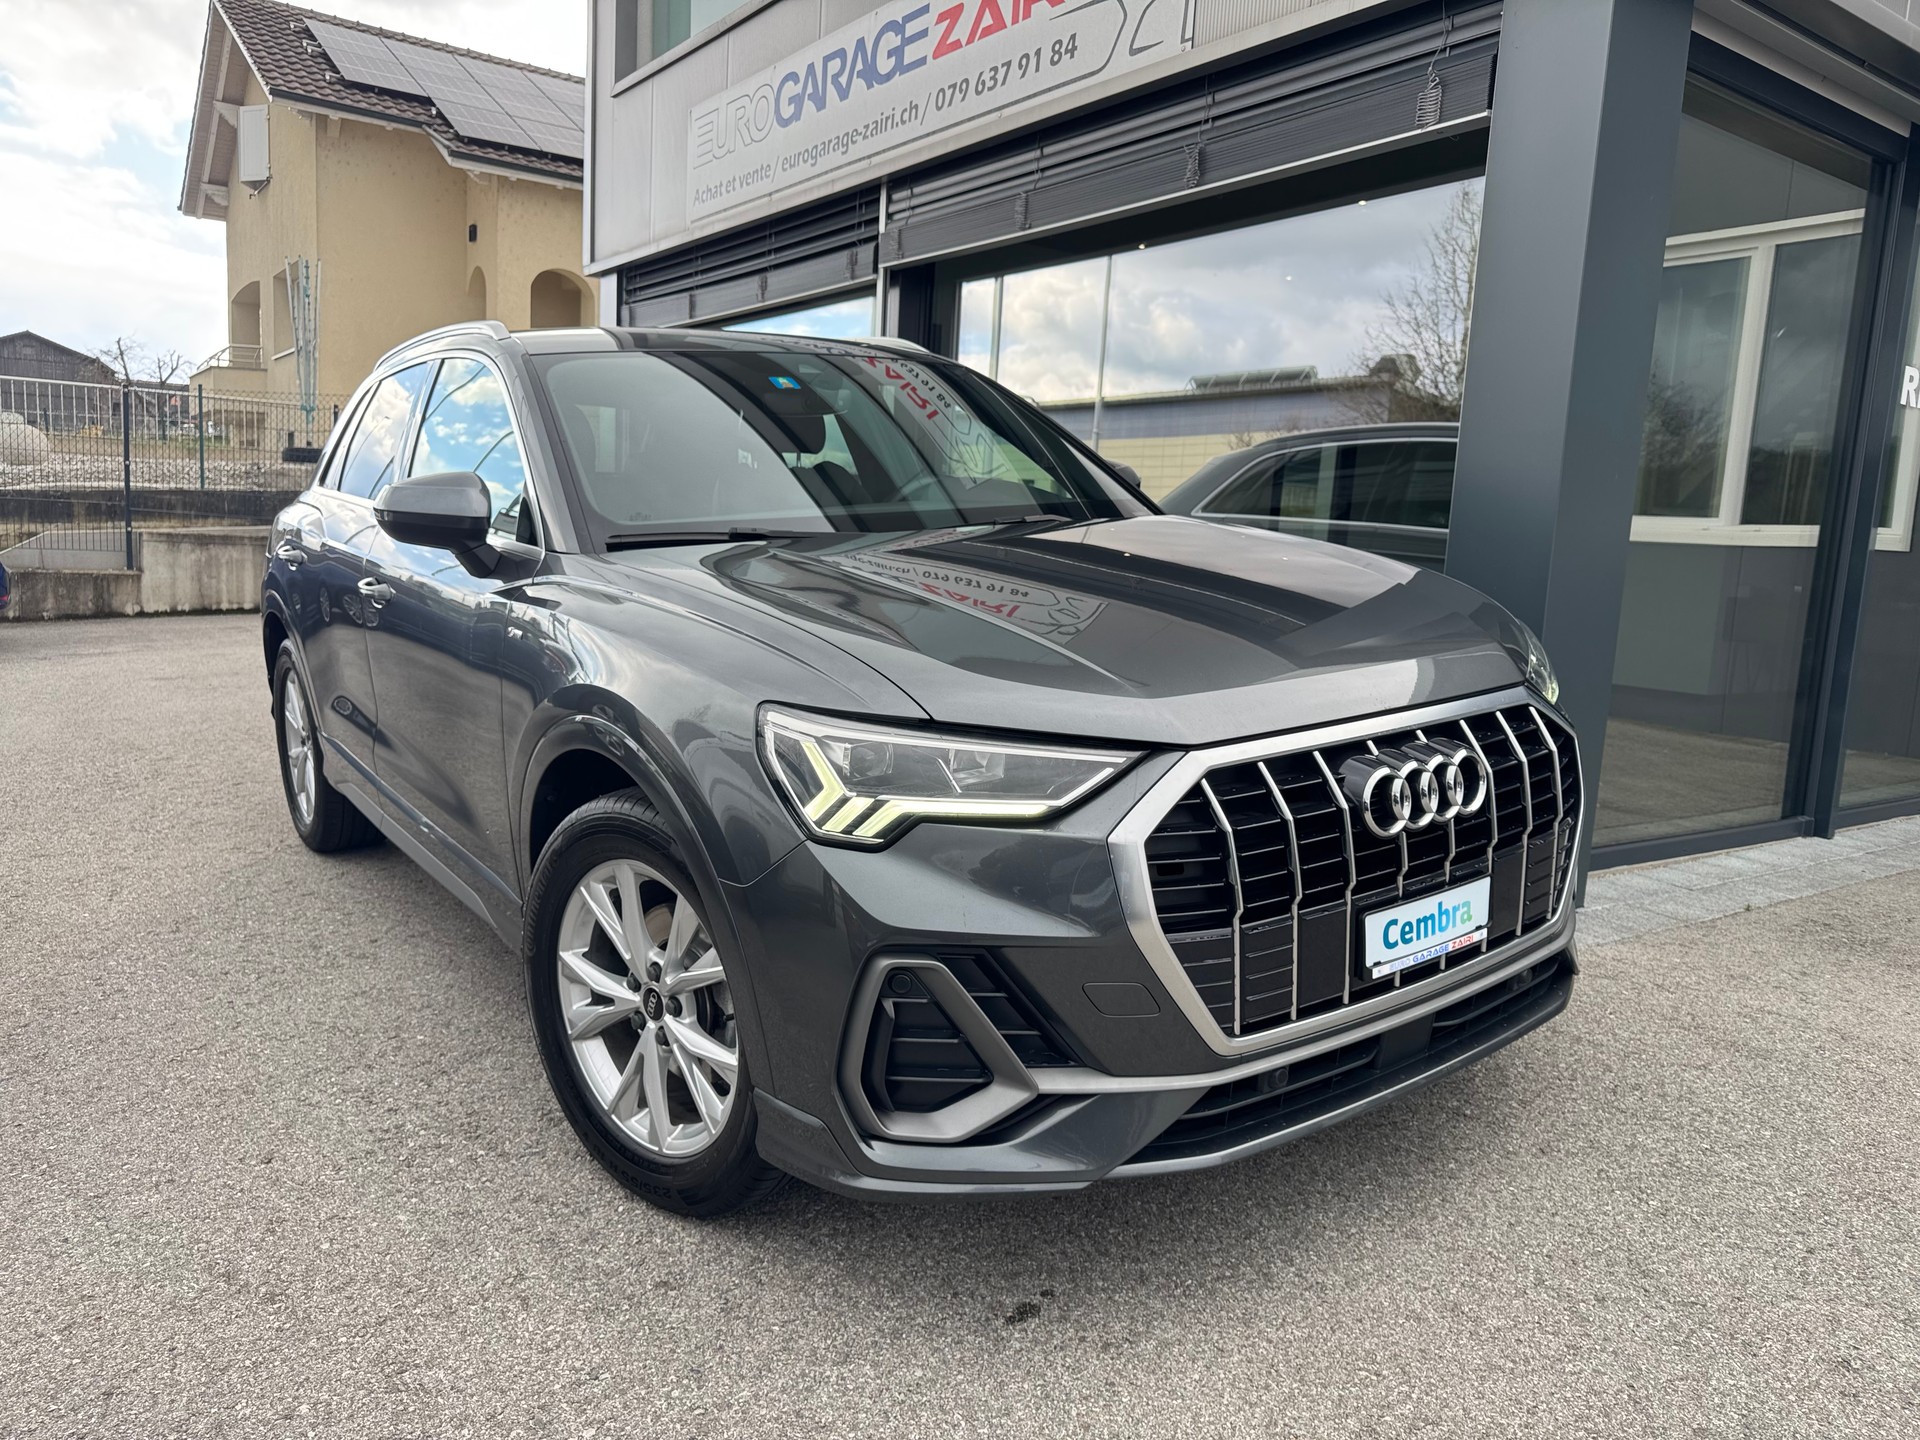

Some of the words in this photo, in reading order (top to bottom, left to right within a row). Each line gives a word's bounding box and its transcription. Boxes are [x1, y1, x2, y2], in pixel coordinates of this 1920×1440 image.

[693, 181, 723, 207] Achat
[725, 175, 736, 194] et
[739, 163, 771, 190] vente
[781, 100, 919, 172] eurogarage-zairi.ch
[935, 78, 970, 112] 079
[974, 60, 1013, 97] 637
[1018, 47, 1042, 80] 91
[1050, 32, 1079, 67] 84
[1900, 365, 1920, 408] R
[1382, 900, 1473, 950] Cembra
[1412, 944, 1449, 963] GARAGE
[1451, 935, 1474, 949] ZAIRI
